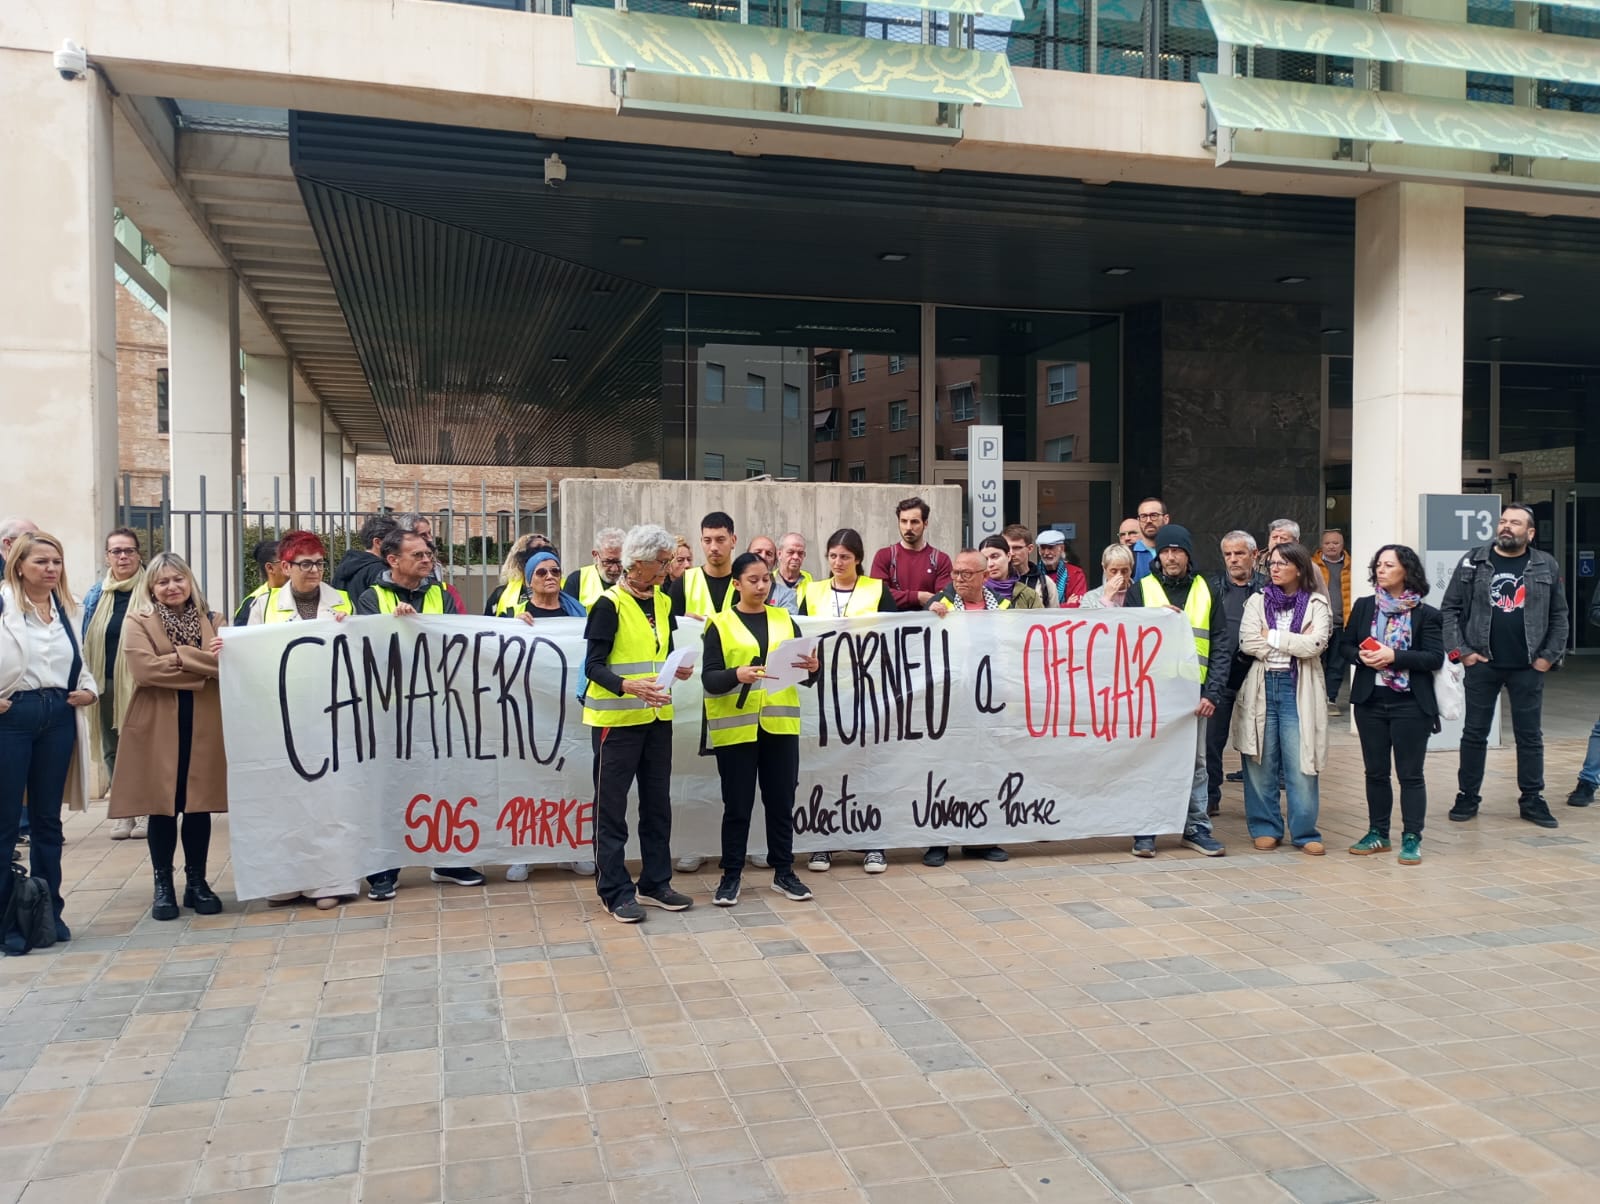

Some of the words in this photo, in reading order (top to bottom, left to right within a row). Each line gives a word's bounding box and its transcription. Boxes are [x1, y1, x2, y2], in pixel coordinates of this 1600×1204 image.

[983, 441, 994, 457] P
[978, 479, 997, 533] CCÉS
[1455, 510, 1494, 541] T3
[279, 632, 566, 781] CAMARERO,
[816, 627, 950, 747] TORNEU
[975, 654, 1007, 715] a
[1023, 620, 1162, 741] OFEGAR
[404, 793, 480, 854] SOS
[496, 797, 593, 848] PARKE
[791, 774, 882, 836] olectivo
[912, 770, 990, 831] Jóvenes
[997, 772, 1062, 829] Parke
